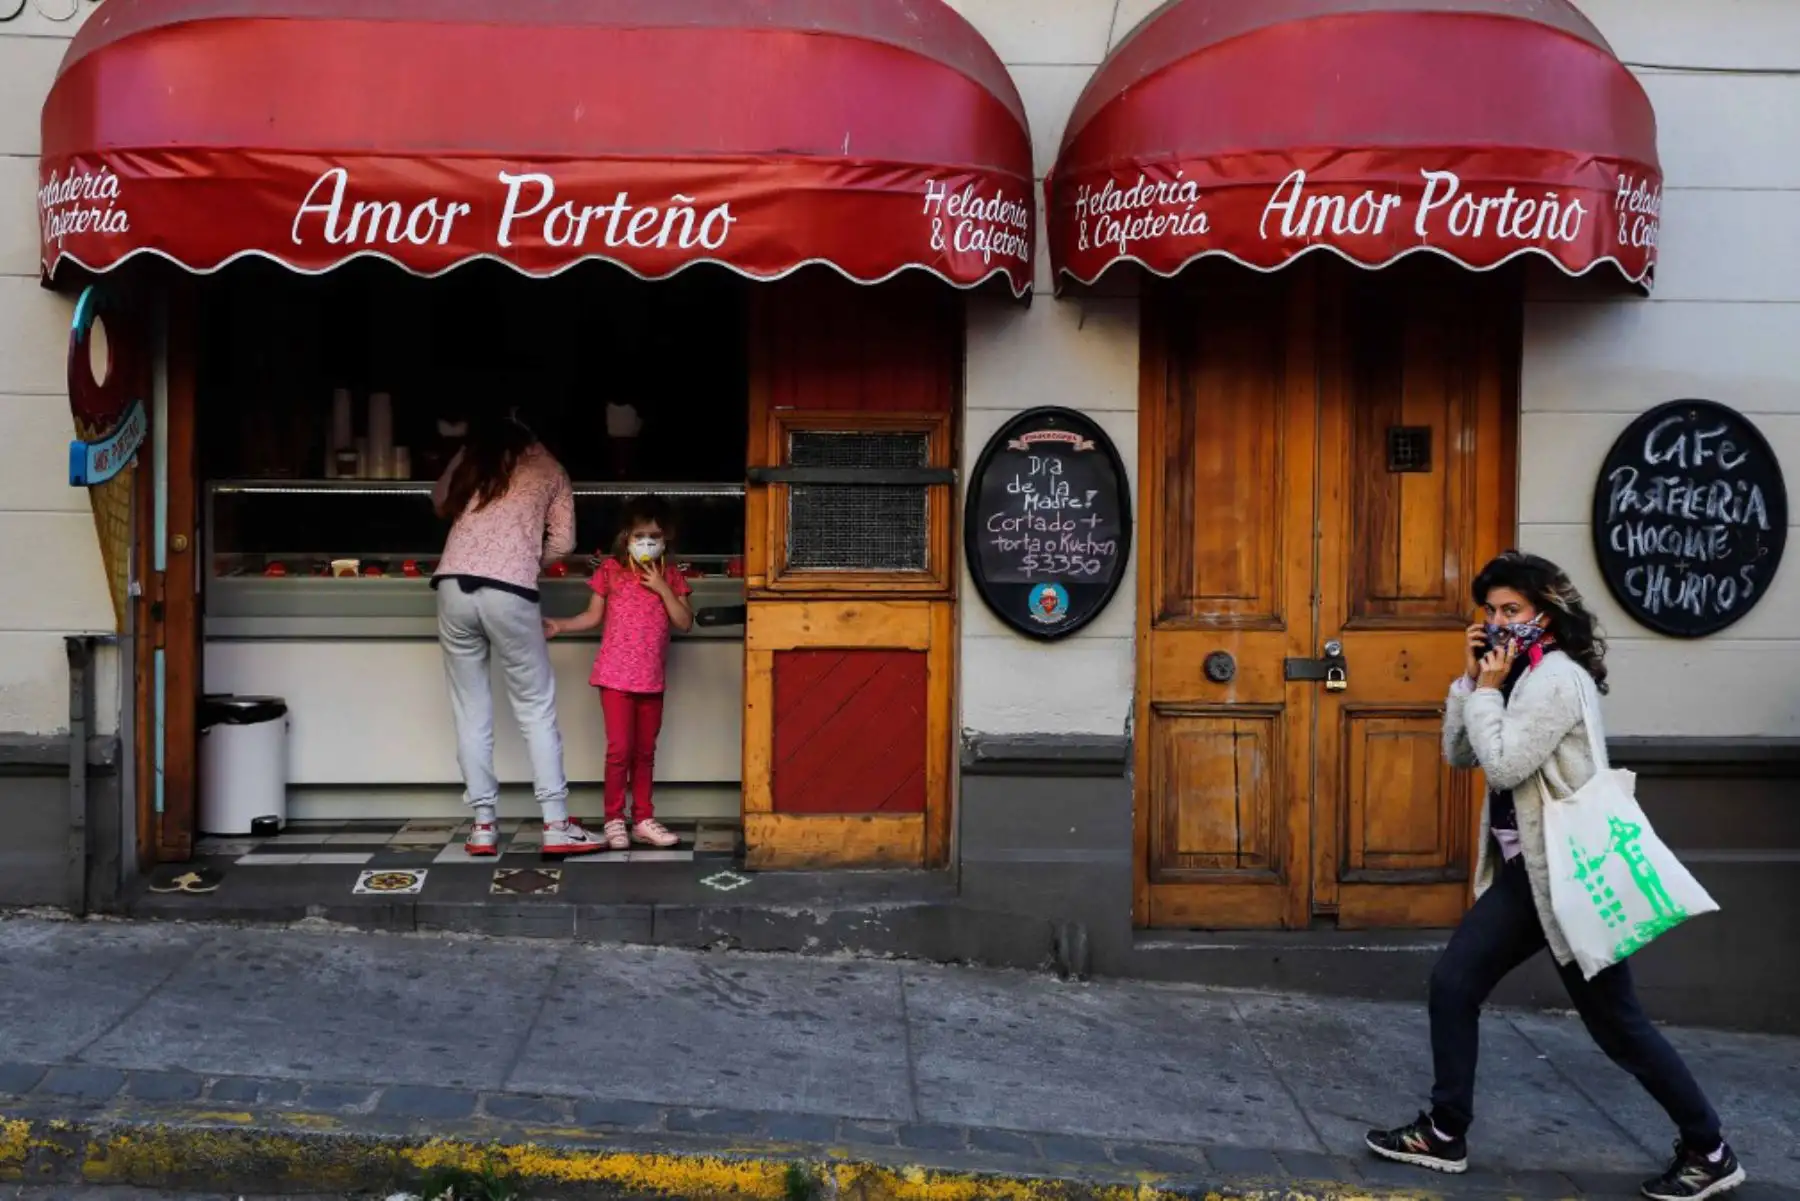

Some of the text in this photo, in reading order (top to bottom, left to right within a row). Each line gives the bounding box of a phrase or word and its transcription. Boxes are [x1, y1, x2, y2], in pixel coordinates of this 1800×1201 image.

[292, 167, 737, 249] Amor Porteño
[1075, 170, 1201, 220] Heladería
[1260, 167, 1588, 242] Amor Porteño
[930, 217, 947, 251] &
[1078, 204, 1210, 255] & Cafetería
[1007, 474, 1070, 497] de la
[987, 510, 1076, 533] Cortado
[990, 532, 1041, 553] torta
[1610, 520, 1732, 562] CHOCOLATE
